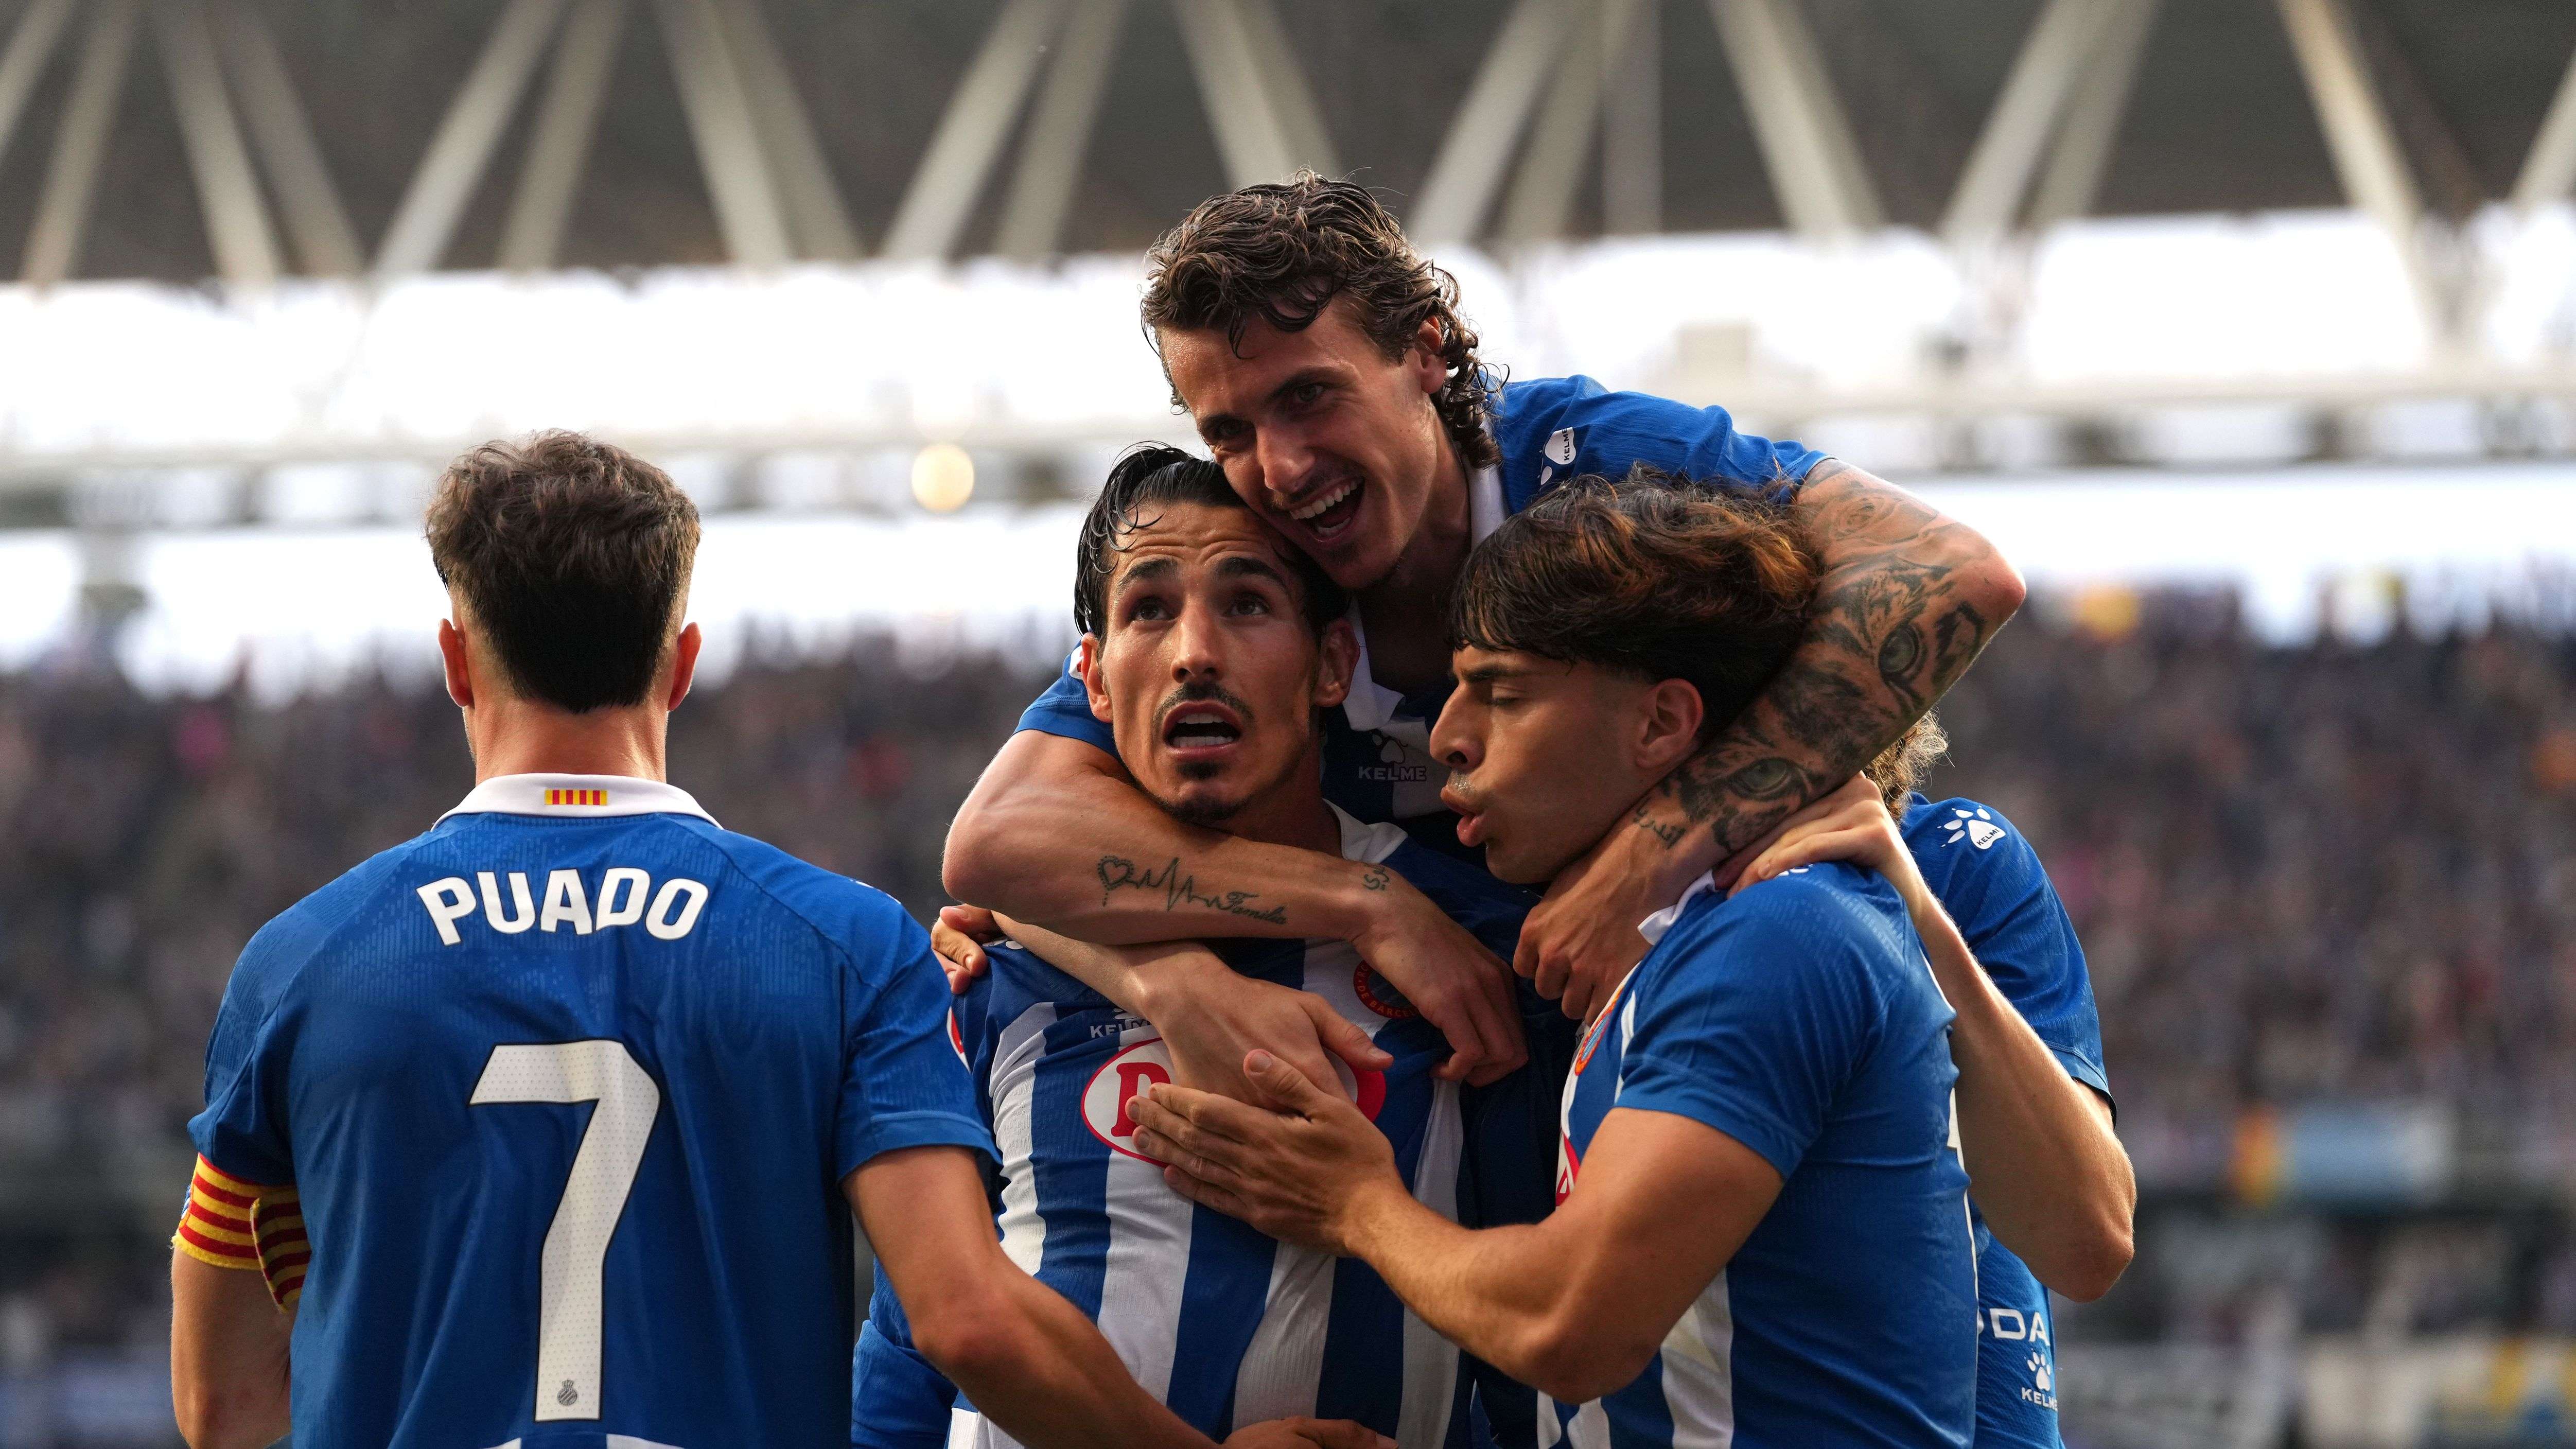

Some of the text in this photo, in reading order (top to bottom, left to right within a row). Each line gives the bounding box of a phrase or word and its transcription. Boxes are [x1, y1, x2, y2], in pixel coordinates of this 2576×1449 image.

[1562, 428, 1570, 461] KELME
[1358, 766, 1427, 782] KELME
[416, 867, 709, 946] PUADO
[469, 1040, 660, 1421] 7
